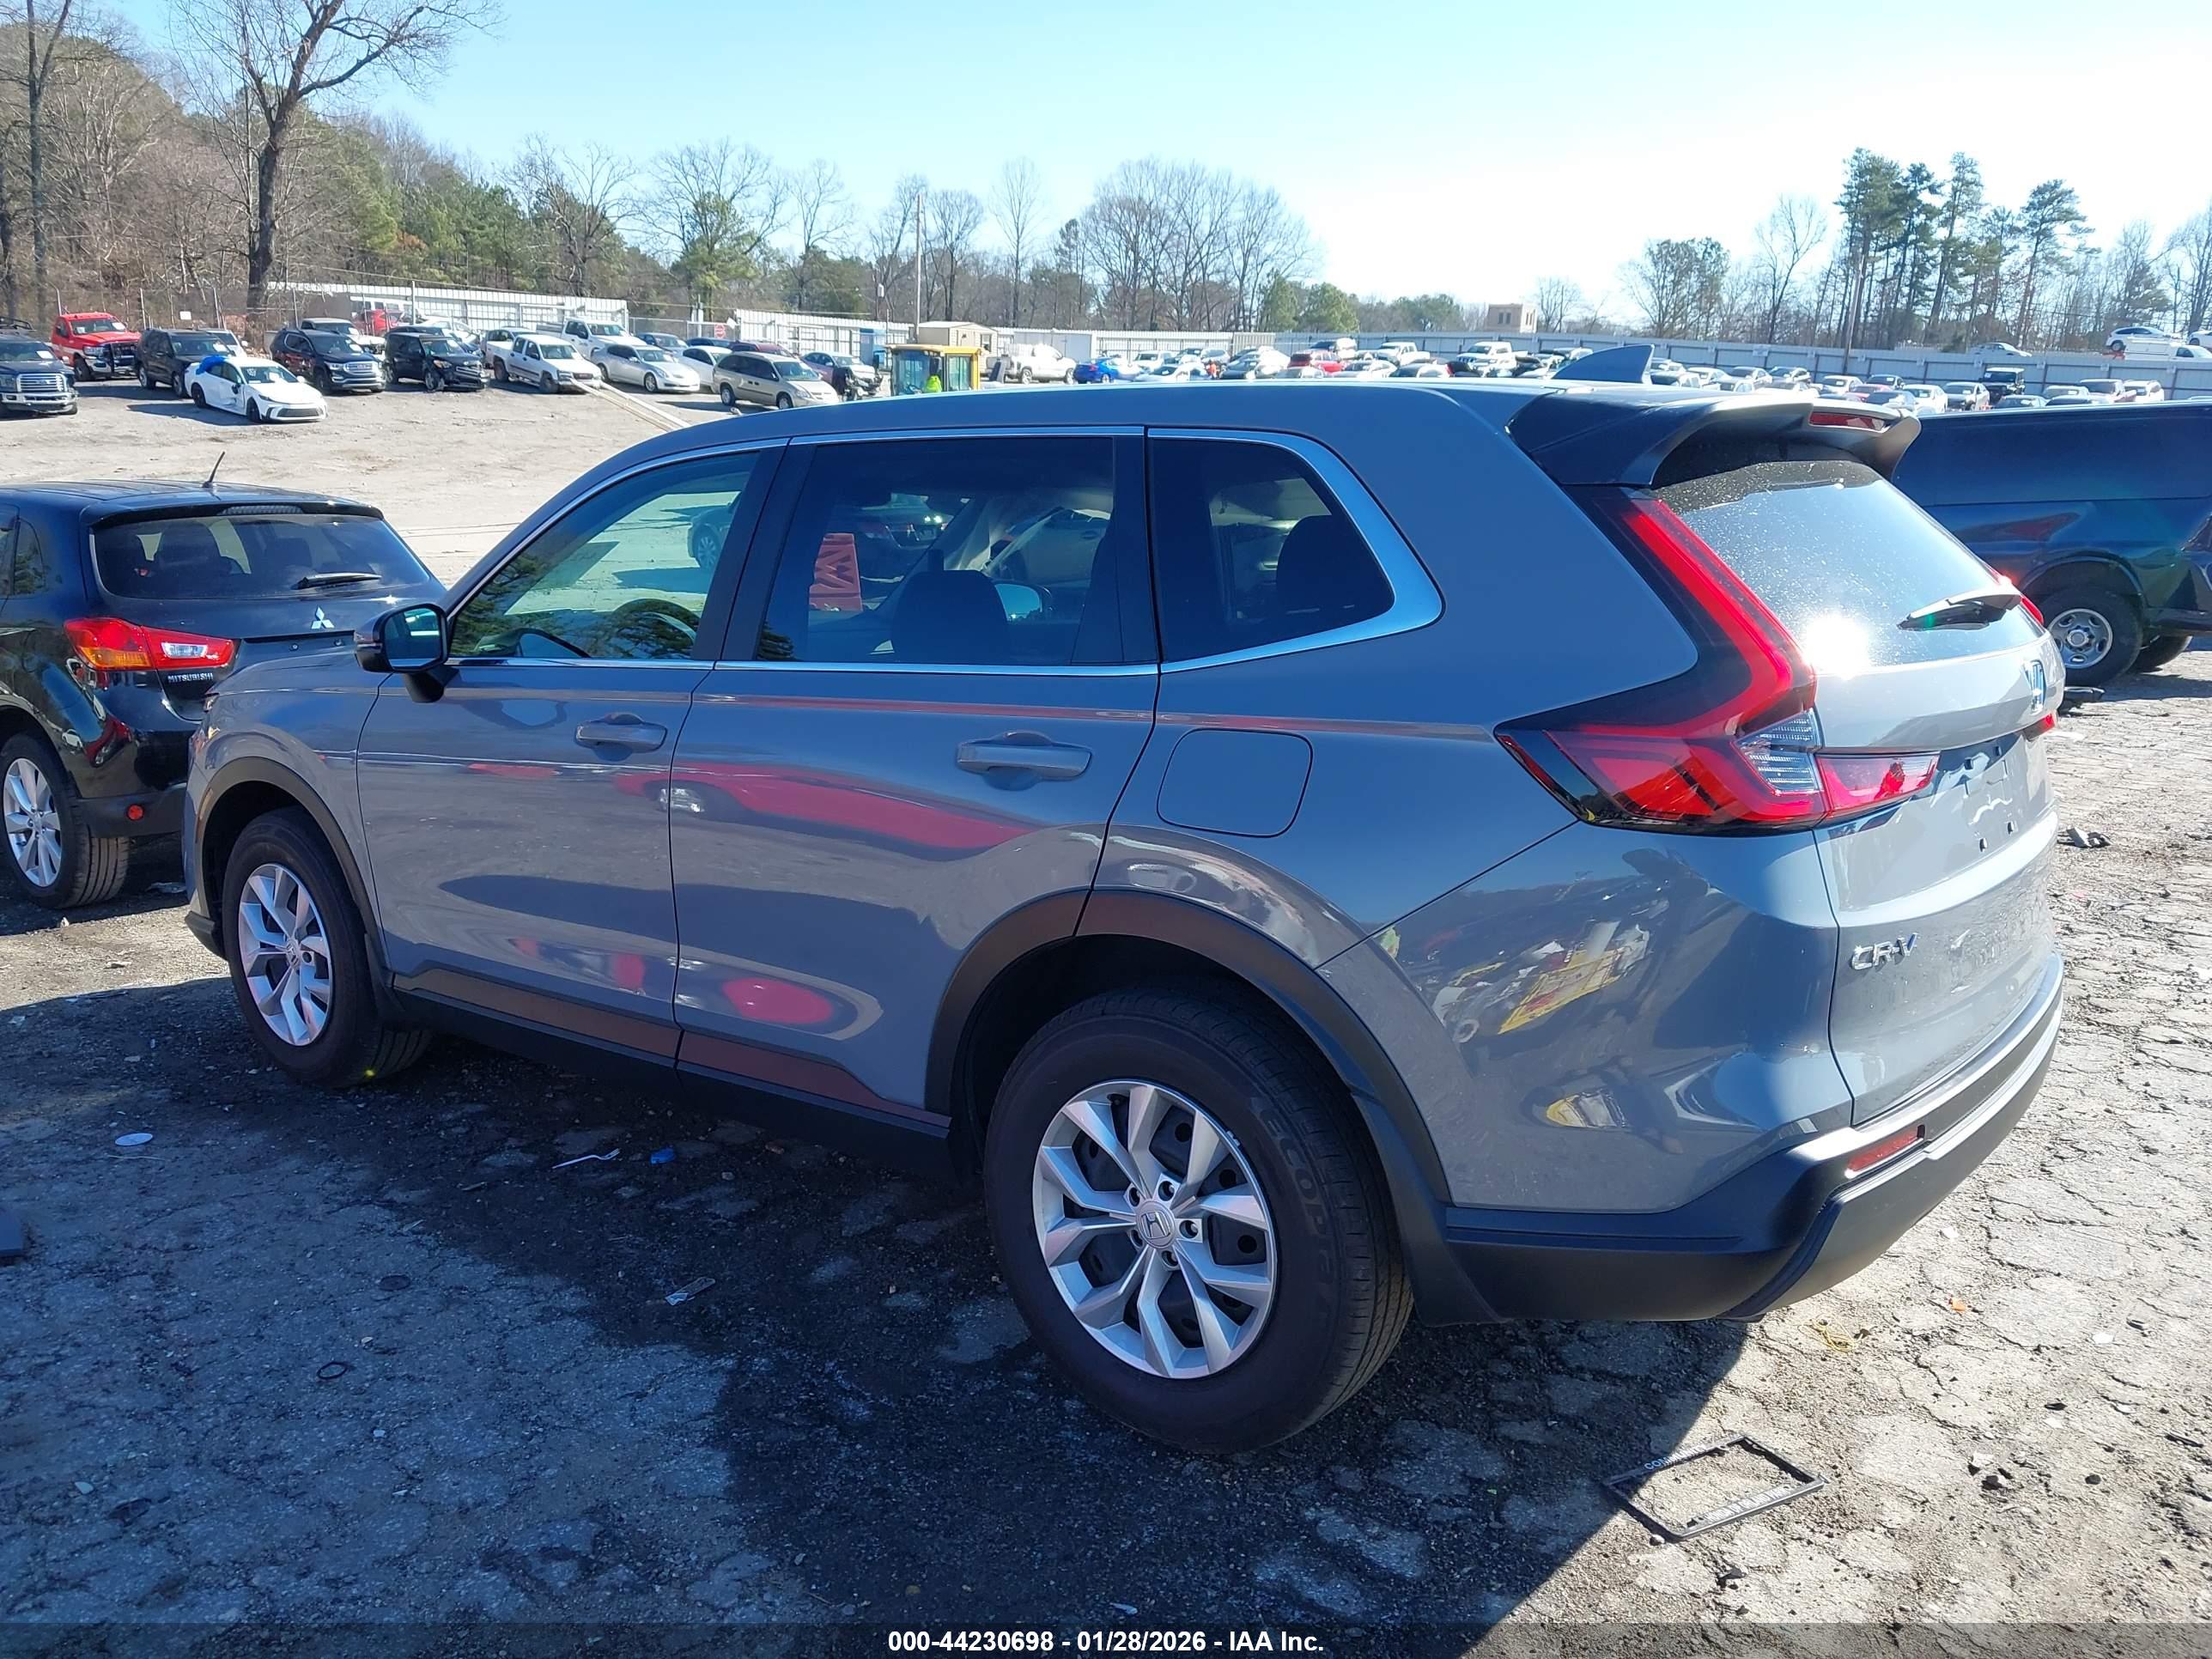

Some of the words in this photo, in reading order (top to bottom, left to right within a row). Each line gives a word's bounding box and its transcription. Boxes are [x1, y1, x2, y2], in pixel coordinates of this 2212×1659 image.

[167, 672, 214, 684] MITSUBISHI
[1851, 933, 1918, 970] CR-V
[1258, 1107, 1334, 1285] ECOPIA
